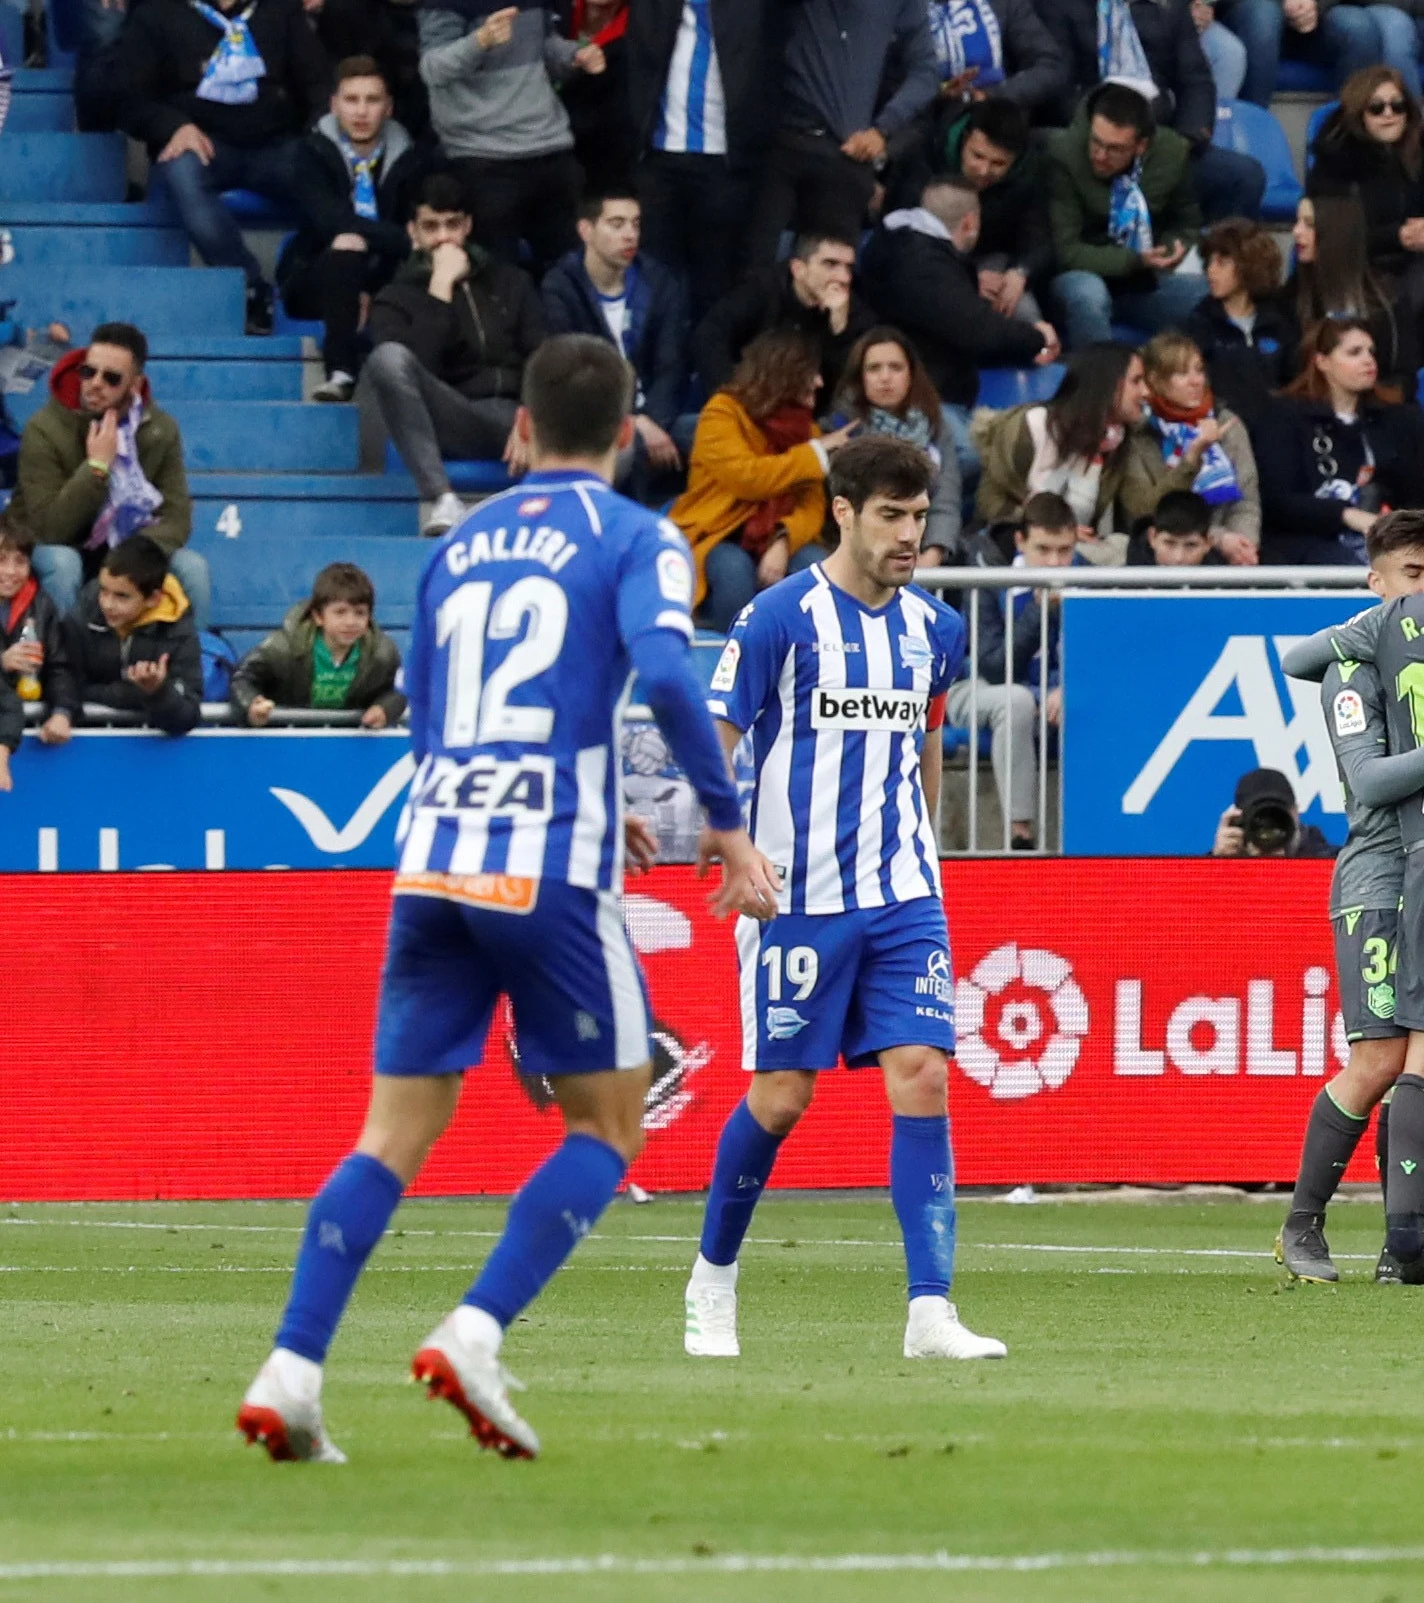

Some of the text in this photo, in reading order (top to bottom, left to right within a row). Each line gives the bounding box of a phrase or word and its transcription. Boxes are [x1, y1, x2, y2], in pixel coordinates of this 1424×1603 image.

[216, 503, 242, 538] 4
[436, 575, 569, 749] 12
[819, 692, 923, 729] betway
[1122, 635, 1346, 814] AX
[762, 945, 818, 1001] 19
